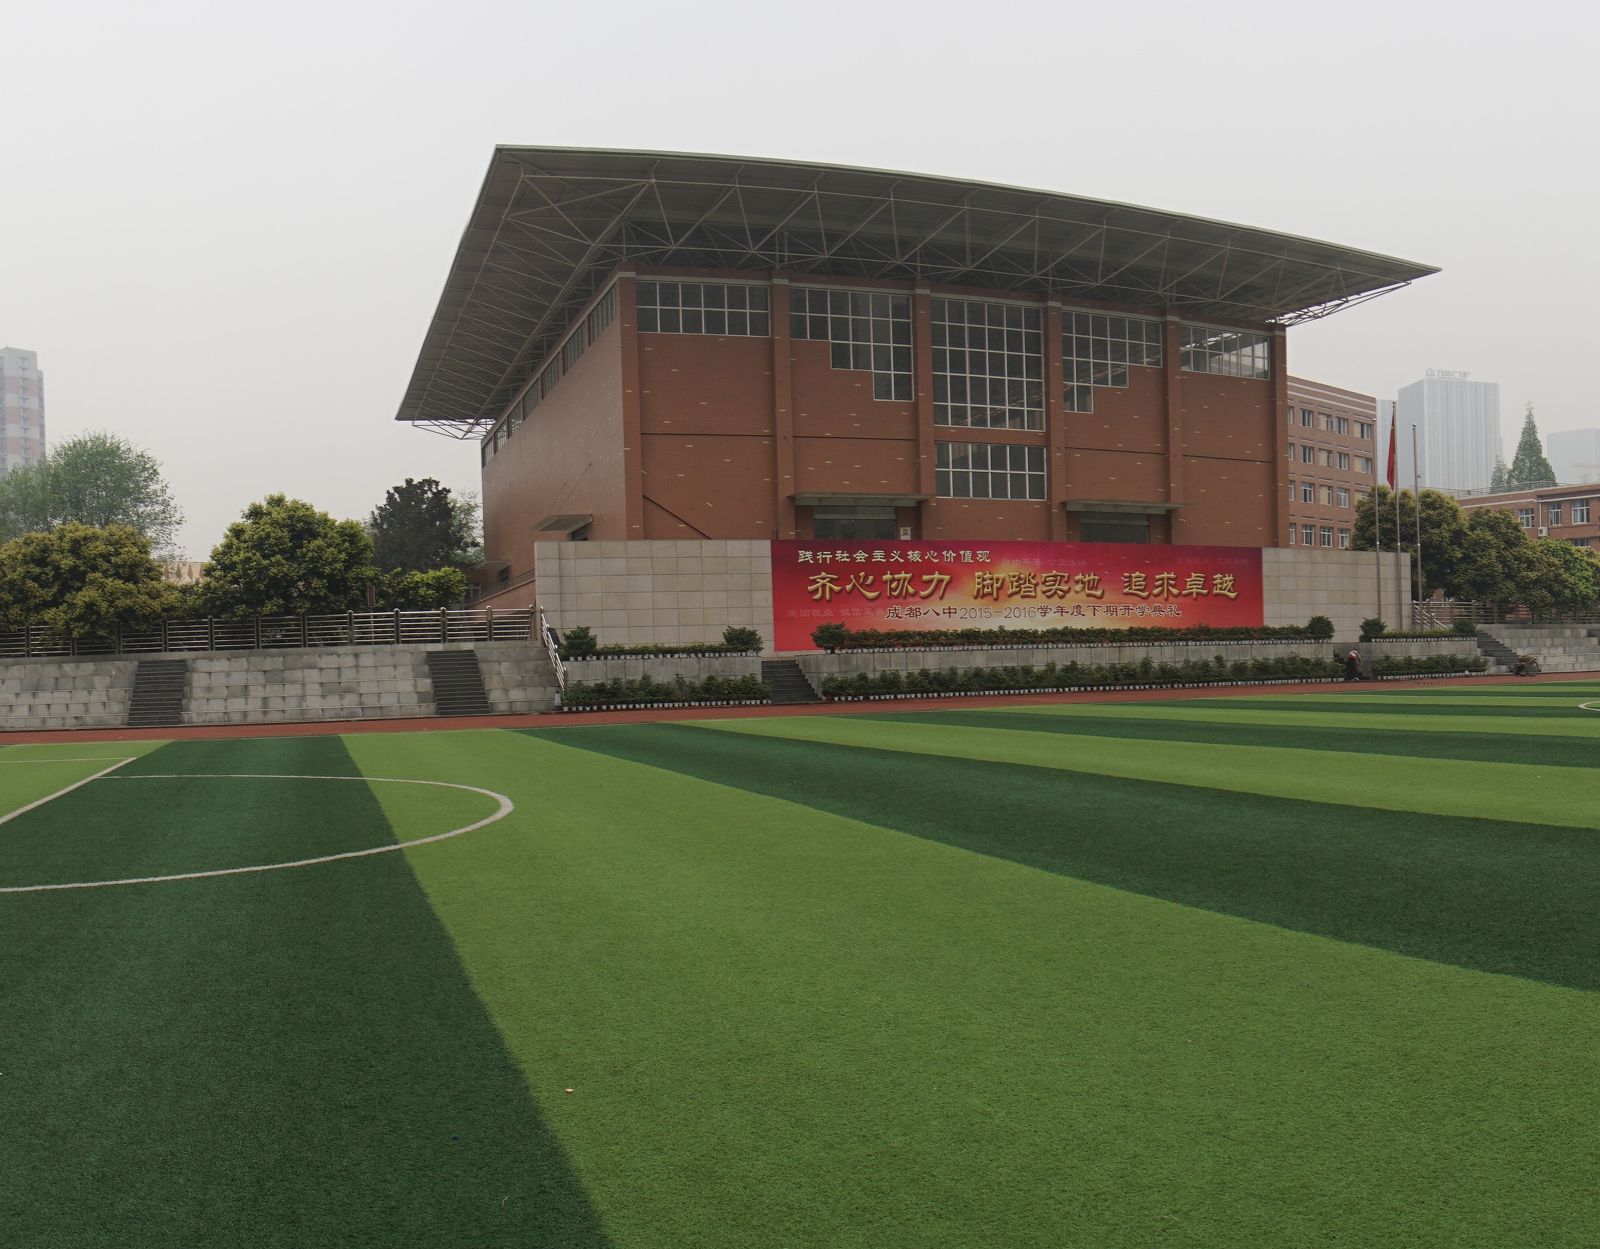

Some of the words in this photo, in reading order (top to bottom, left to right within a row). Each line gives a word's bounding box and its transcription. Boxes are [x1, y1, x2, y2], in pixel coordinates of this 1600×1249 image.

[797, 549, 991, 564] 践行社会主义核心价值观
[807, 570, 952, 601] 齐心协力
[973, 570, 1105, 600] 脚踏实地
[1121, 571, 1239, 600] 追求卓越
